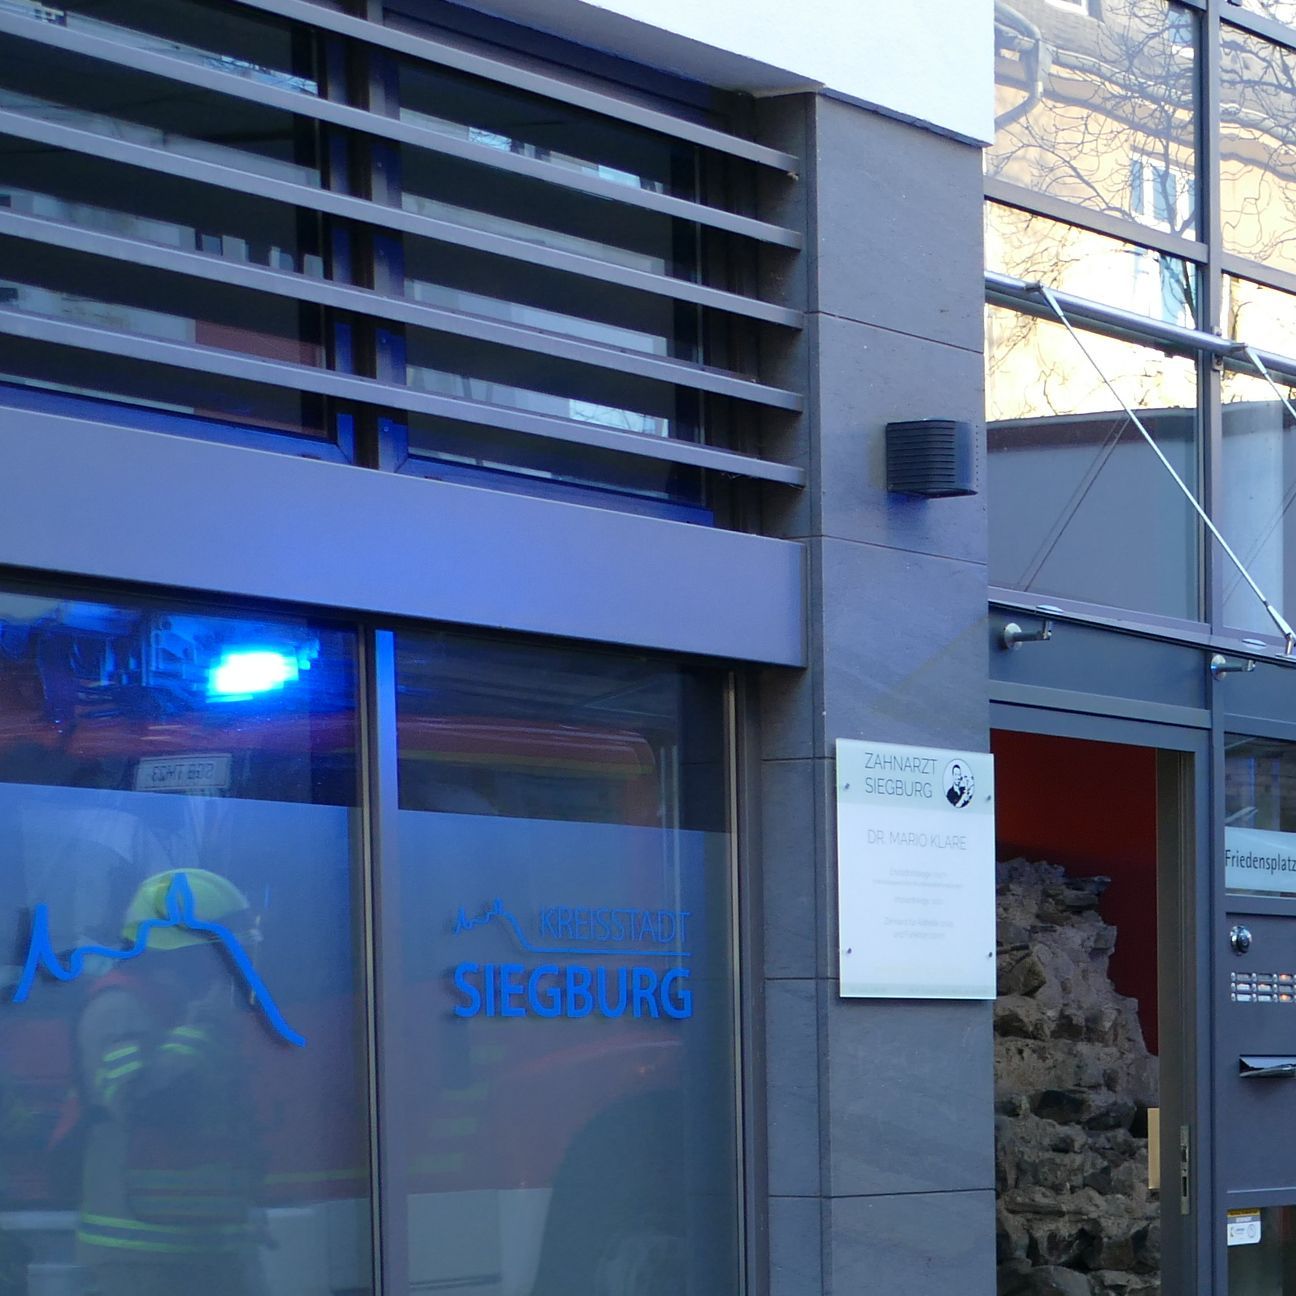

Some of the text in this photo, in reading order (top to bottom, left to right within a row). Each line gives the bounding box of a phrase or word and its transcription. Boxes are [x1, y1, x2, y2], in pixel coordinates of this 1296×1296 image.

[864, 752, 938, 776] ZAHNARZT
[865, 777, 933, 799] SIEGBURG
[889, 832, 928, 848] MARIO
[930, 836, 968, 850] KLARE
[1225, 849, 1296, 875] Friedensplatz
[540, 906, 692, 943] KREISSTADT
[454, 960, 693, 1019] SIEGBURG
